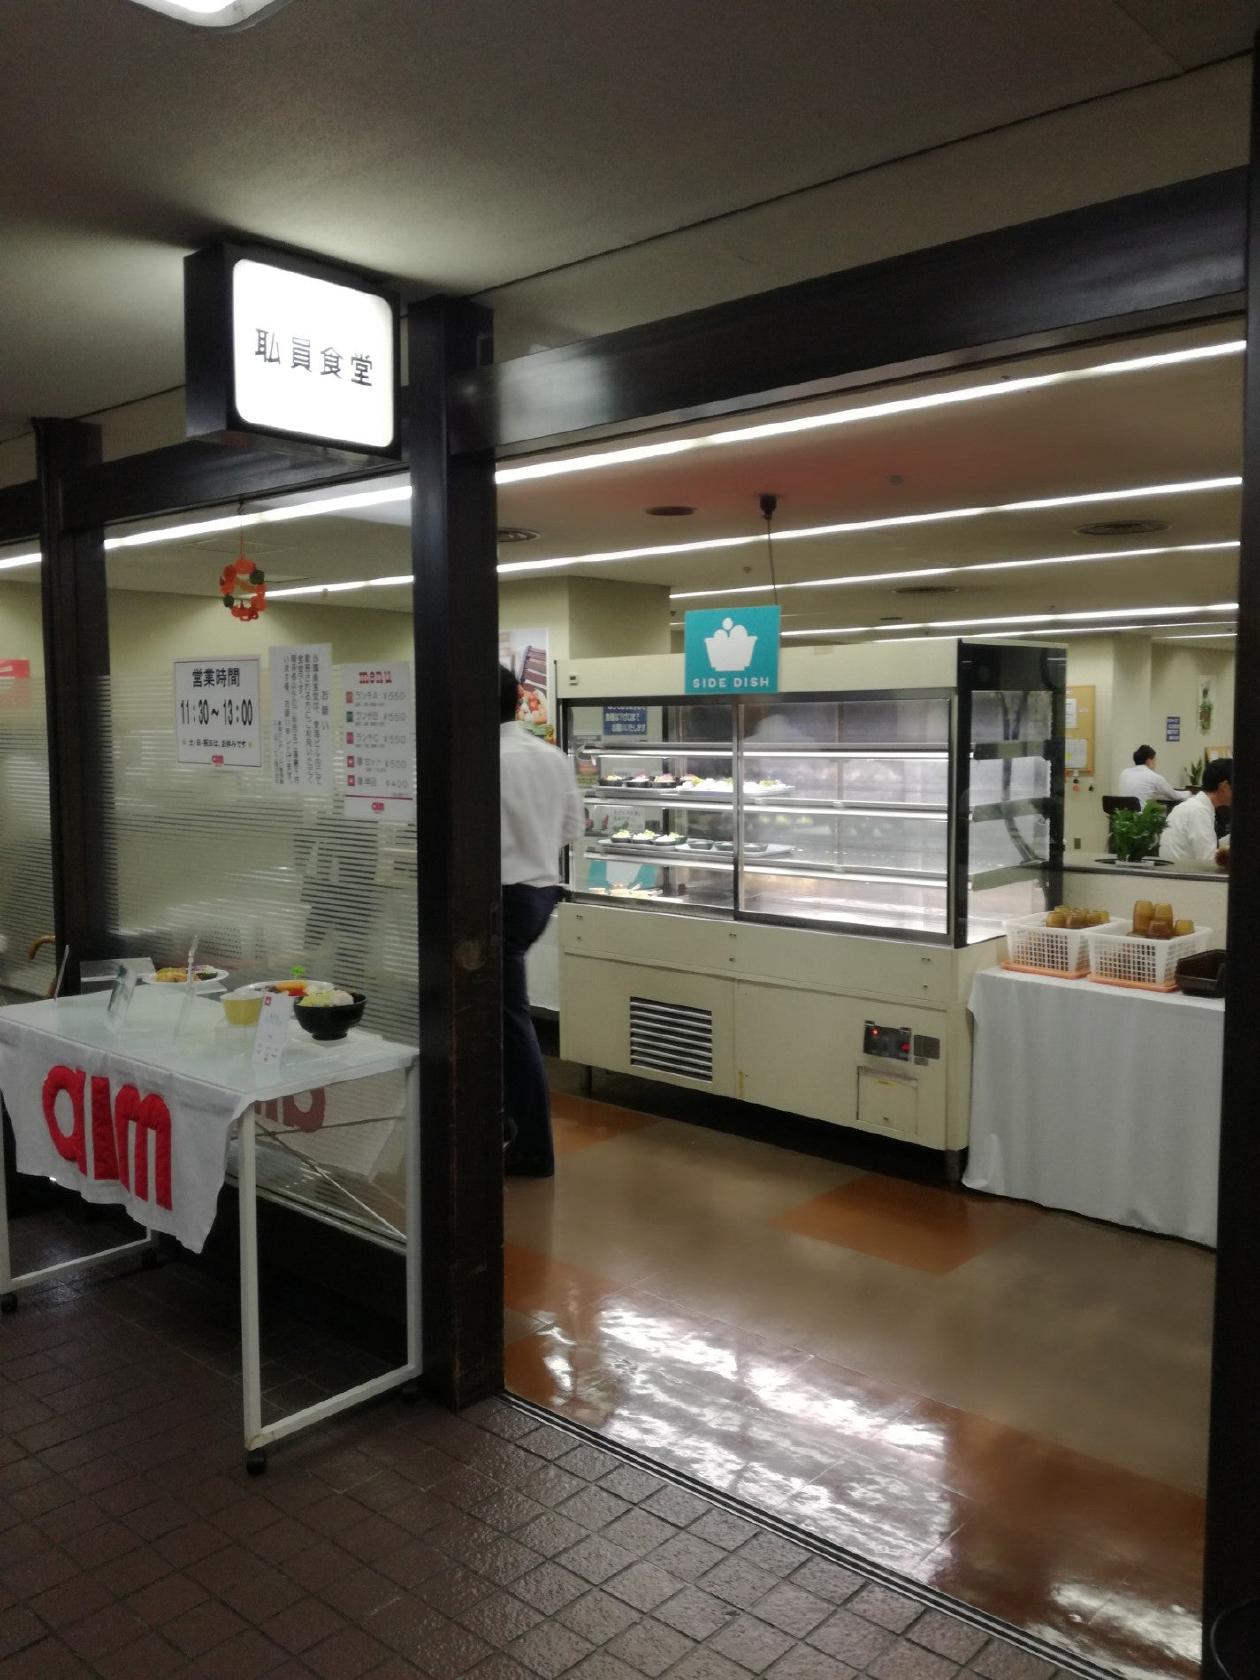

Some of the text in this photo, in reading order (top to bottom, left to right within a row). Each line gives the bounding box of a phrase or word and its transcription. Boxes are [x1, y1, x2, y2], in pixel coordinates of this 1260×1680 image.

[192, 667, 240, 687] 営業時間
[359, 670, 392, 684] menu
[692, 676, 771, 689] SIDE DISH
